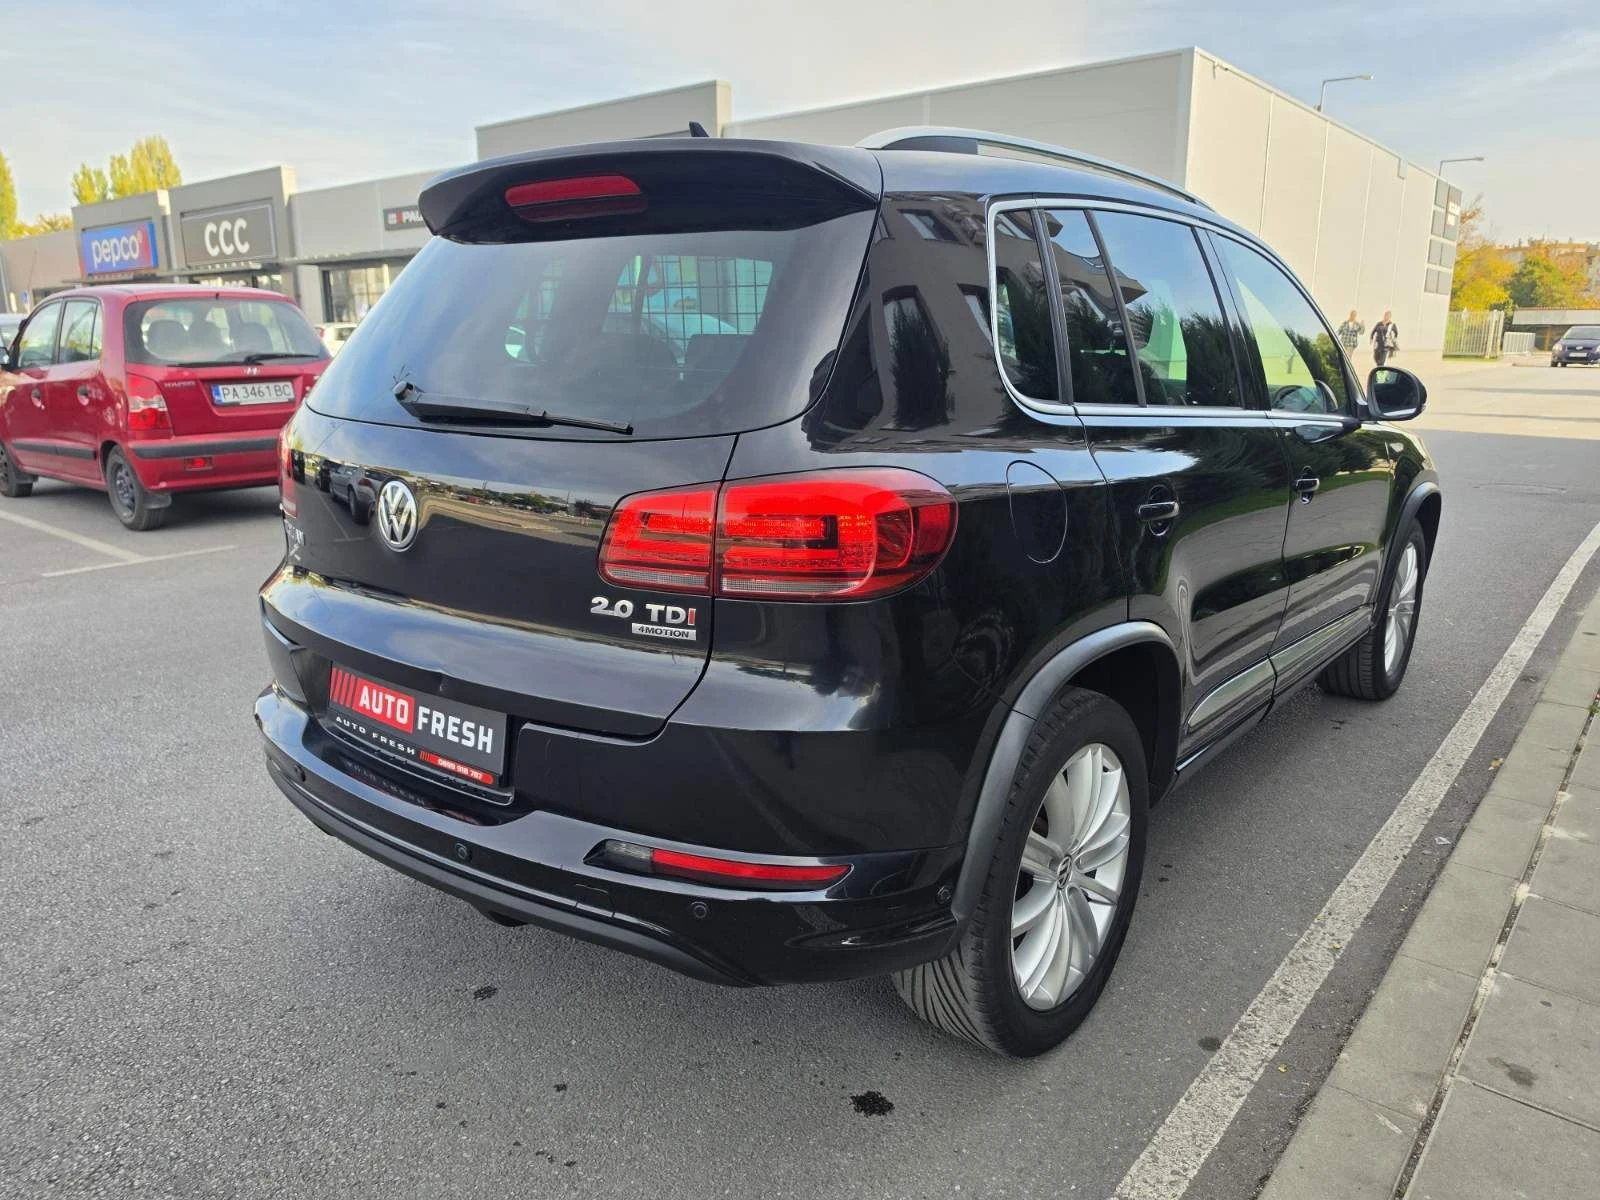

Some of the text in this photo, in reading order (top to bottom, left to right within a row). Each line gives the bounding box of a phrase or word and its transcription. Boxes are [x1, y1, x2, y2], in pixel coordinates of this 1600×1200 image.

[91, 235, 140, 270] pepco
[204, 217, 250, 257] CCC
[222, 383, 292, 400] PA 3461 BC
[590, 596, 697, 626] 2.0 TDI
[638, 626, 690, 639] 4MOTION
[335, 715, 416, 756] AUTO FRESH
[359, 685, 494, 754] AUTO FRESH
